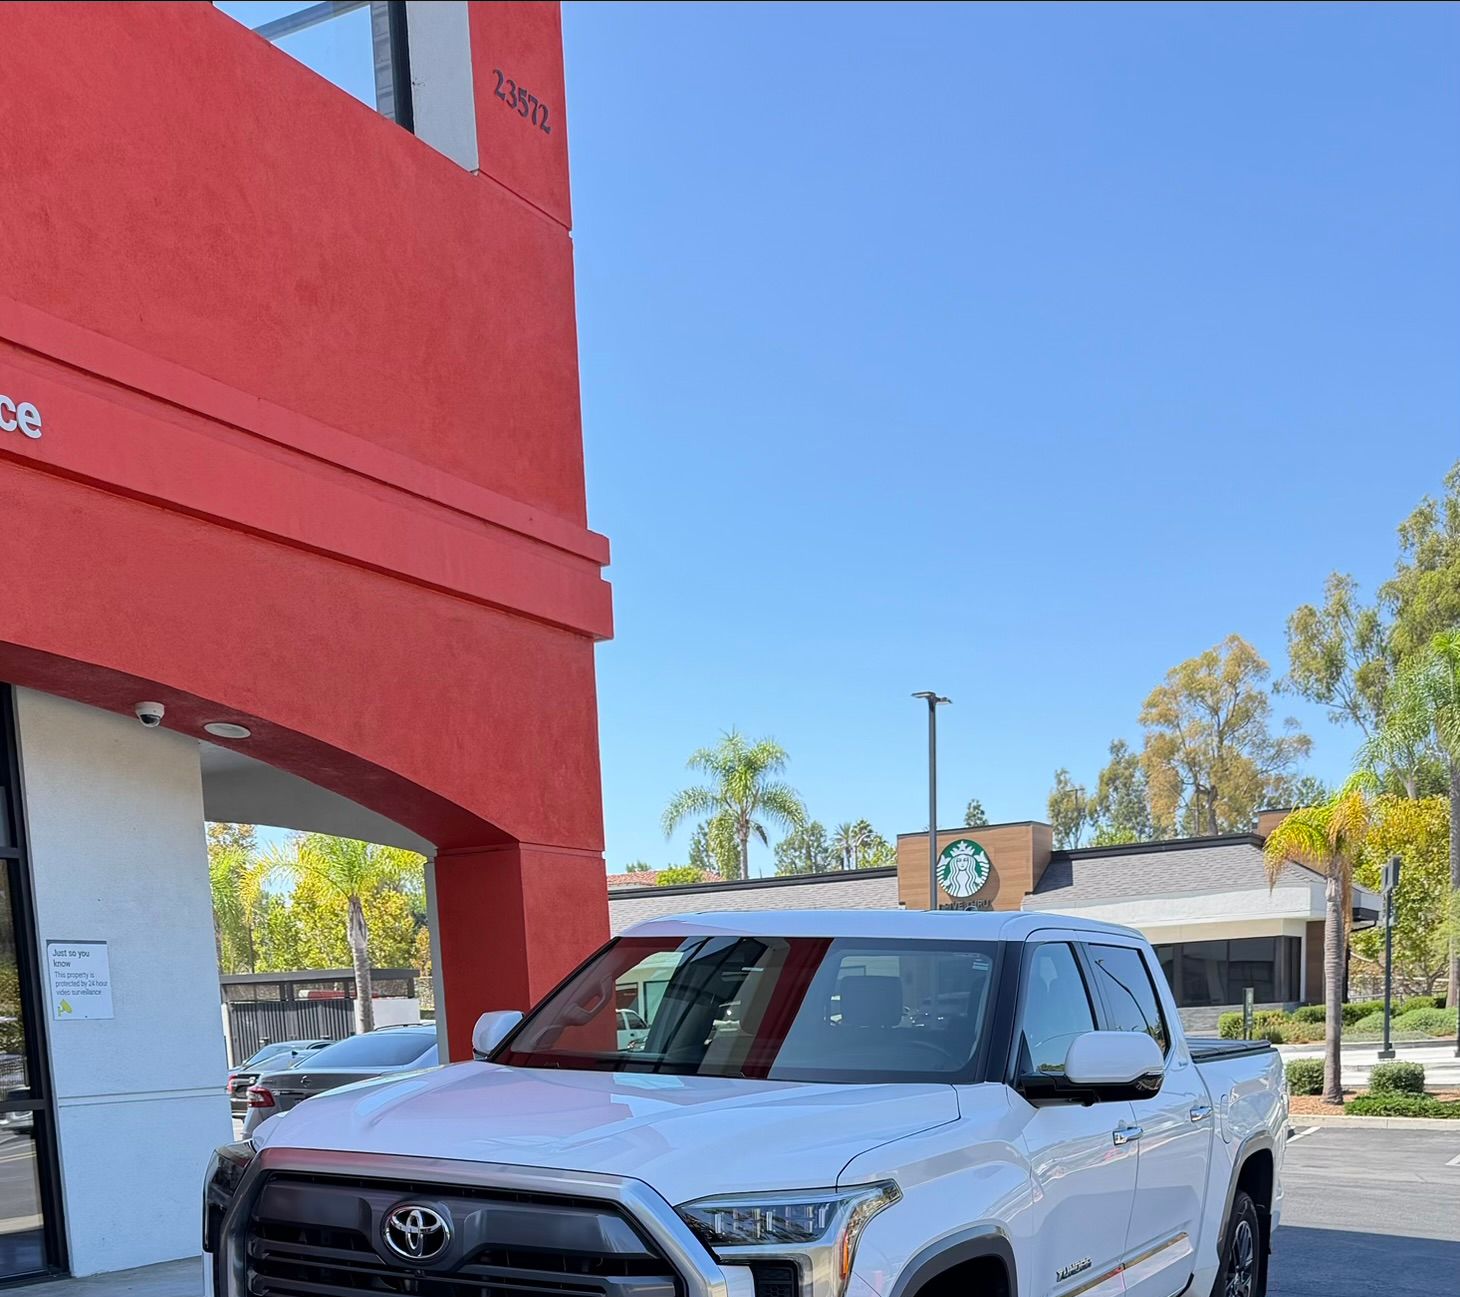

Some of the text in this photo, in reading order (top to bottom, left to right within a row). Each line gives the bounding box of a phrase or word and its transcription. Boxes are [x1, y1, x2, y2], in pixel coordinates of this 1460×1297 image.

[492, 69, 551, 135] 23572
[52, 949, 67, 957] Just
[77, 950, 90, 959] you
[53, 959, 71, 968] know
[55, 980, 80, 988] protected
[80, 980, 88, 988] by
[56, 988, 71, 996] video
